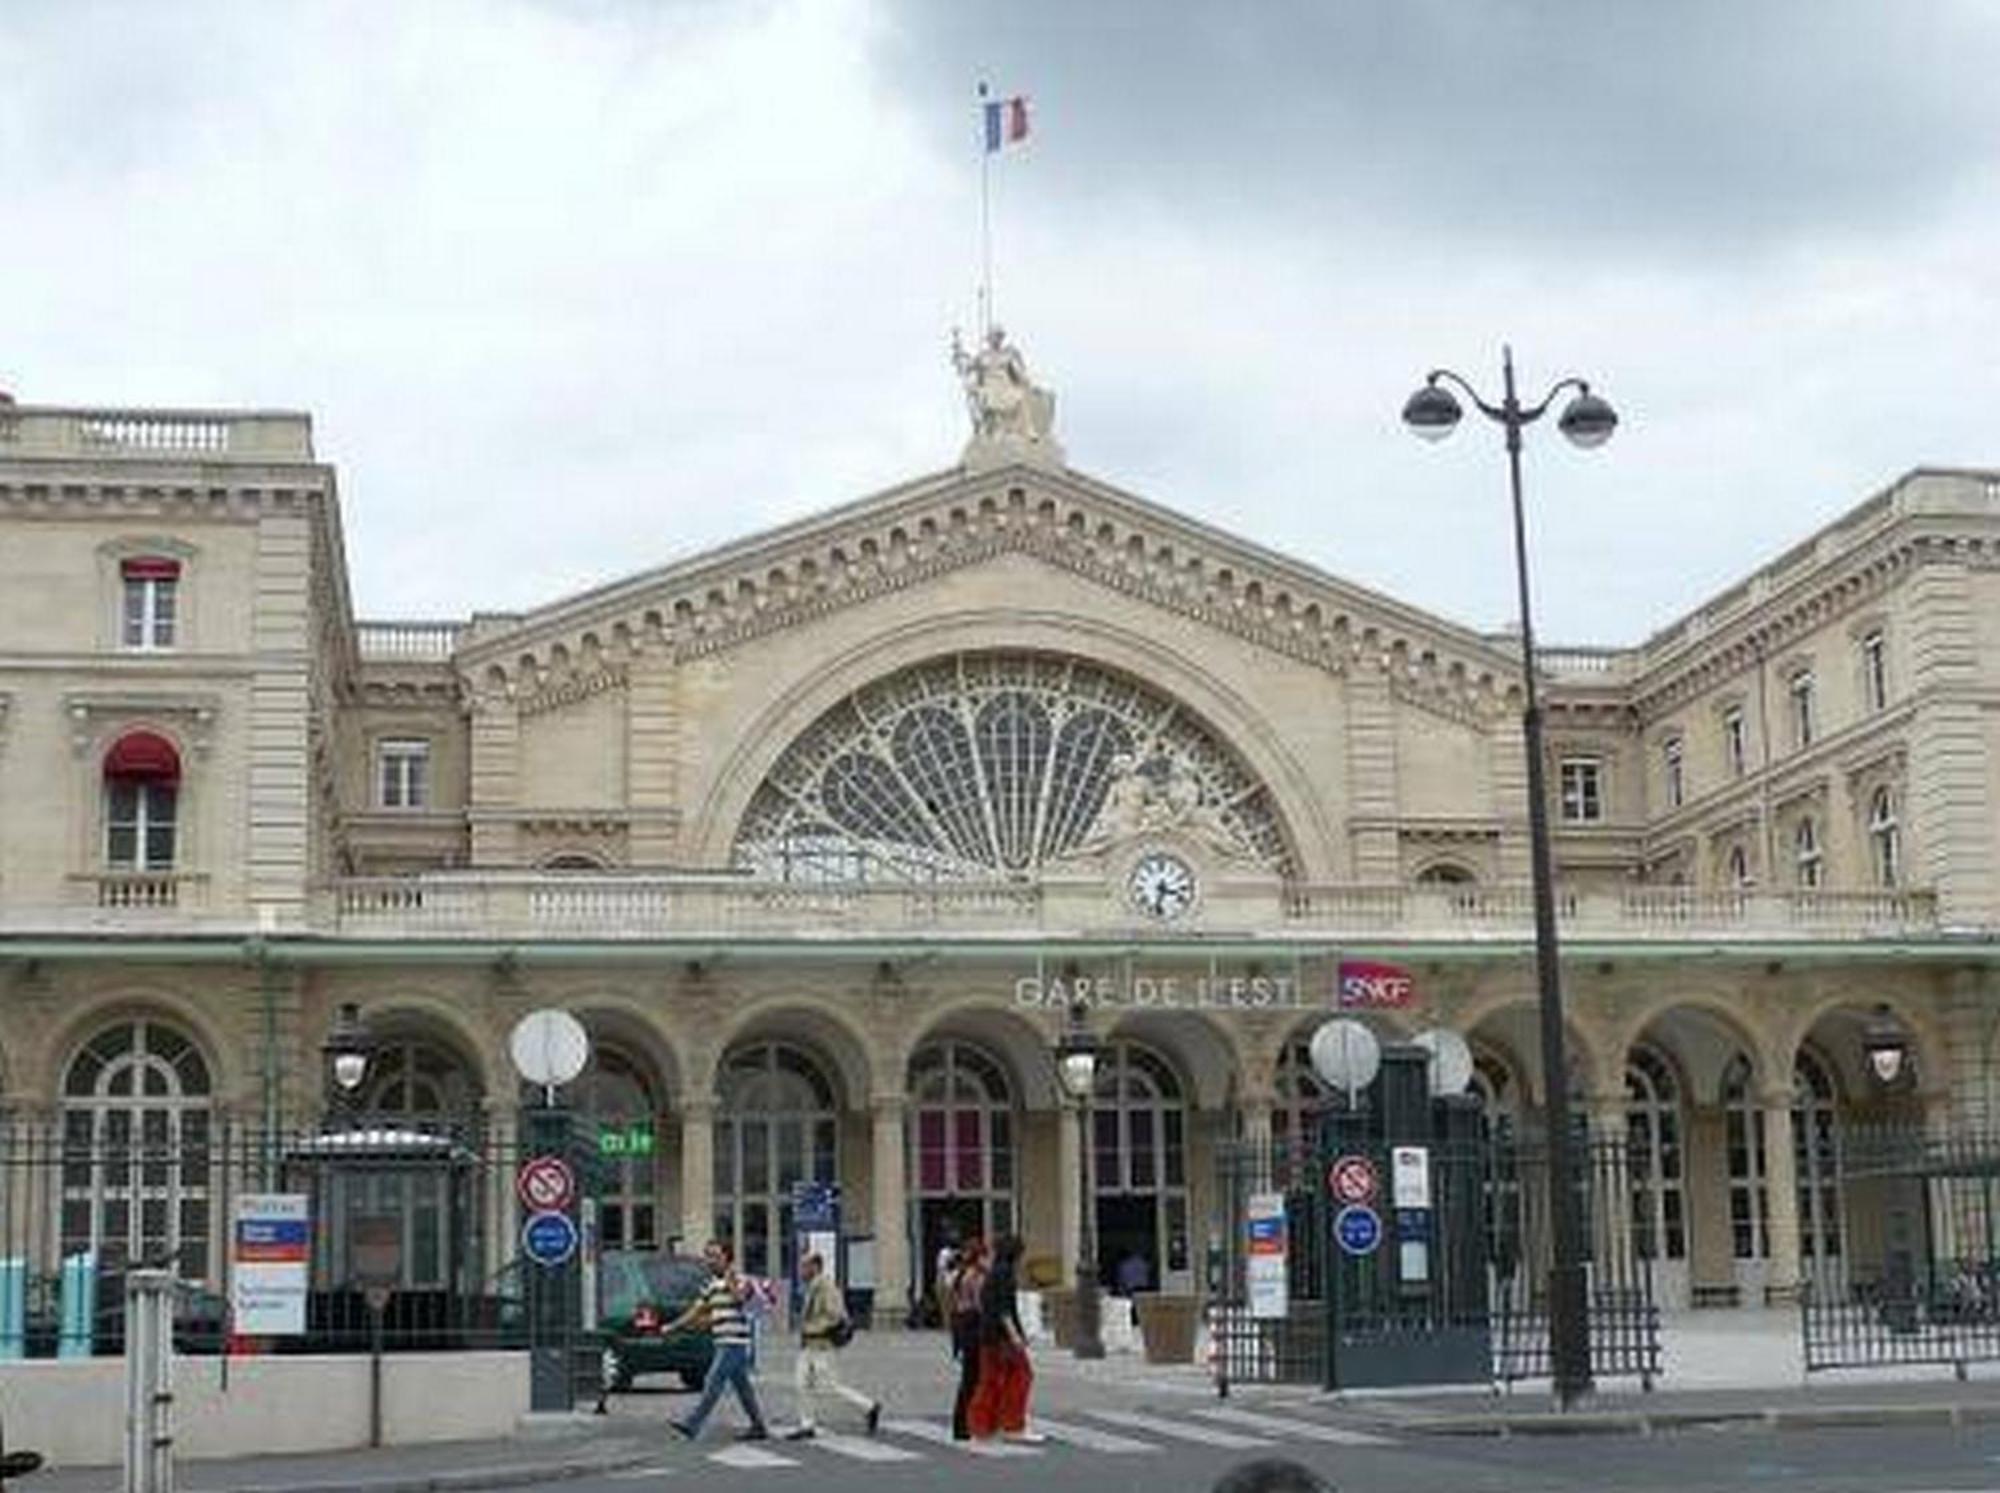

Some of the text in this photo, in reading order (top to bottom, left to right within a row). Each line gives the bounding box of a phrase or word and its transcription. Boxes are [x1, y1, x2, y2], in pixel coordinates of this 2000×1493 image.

[1015, 977, 1117, 1008] GARE
[1134, 977, 1180, 1007] DE
[1342, 977, 1411, 1003] SNCF
